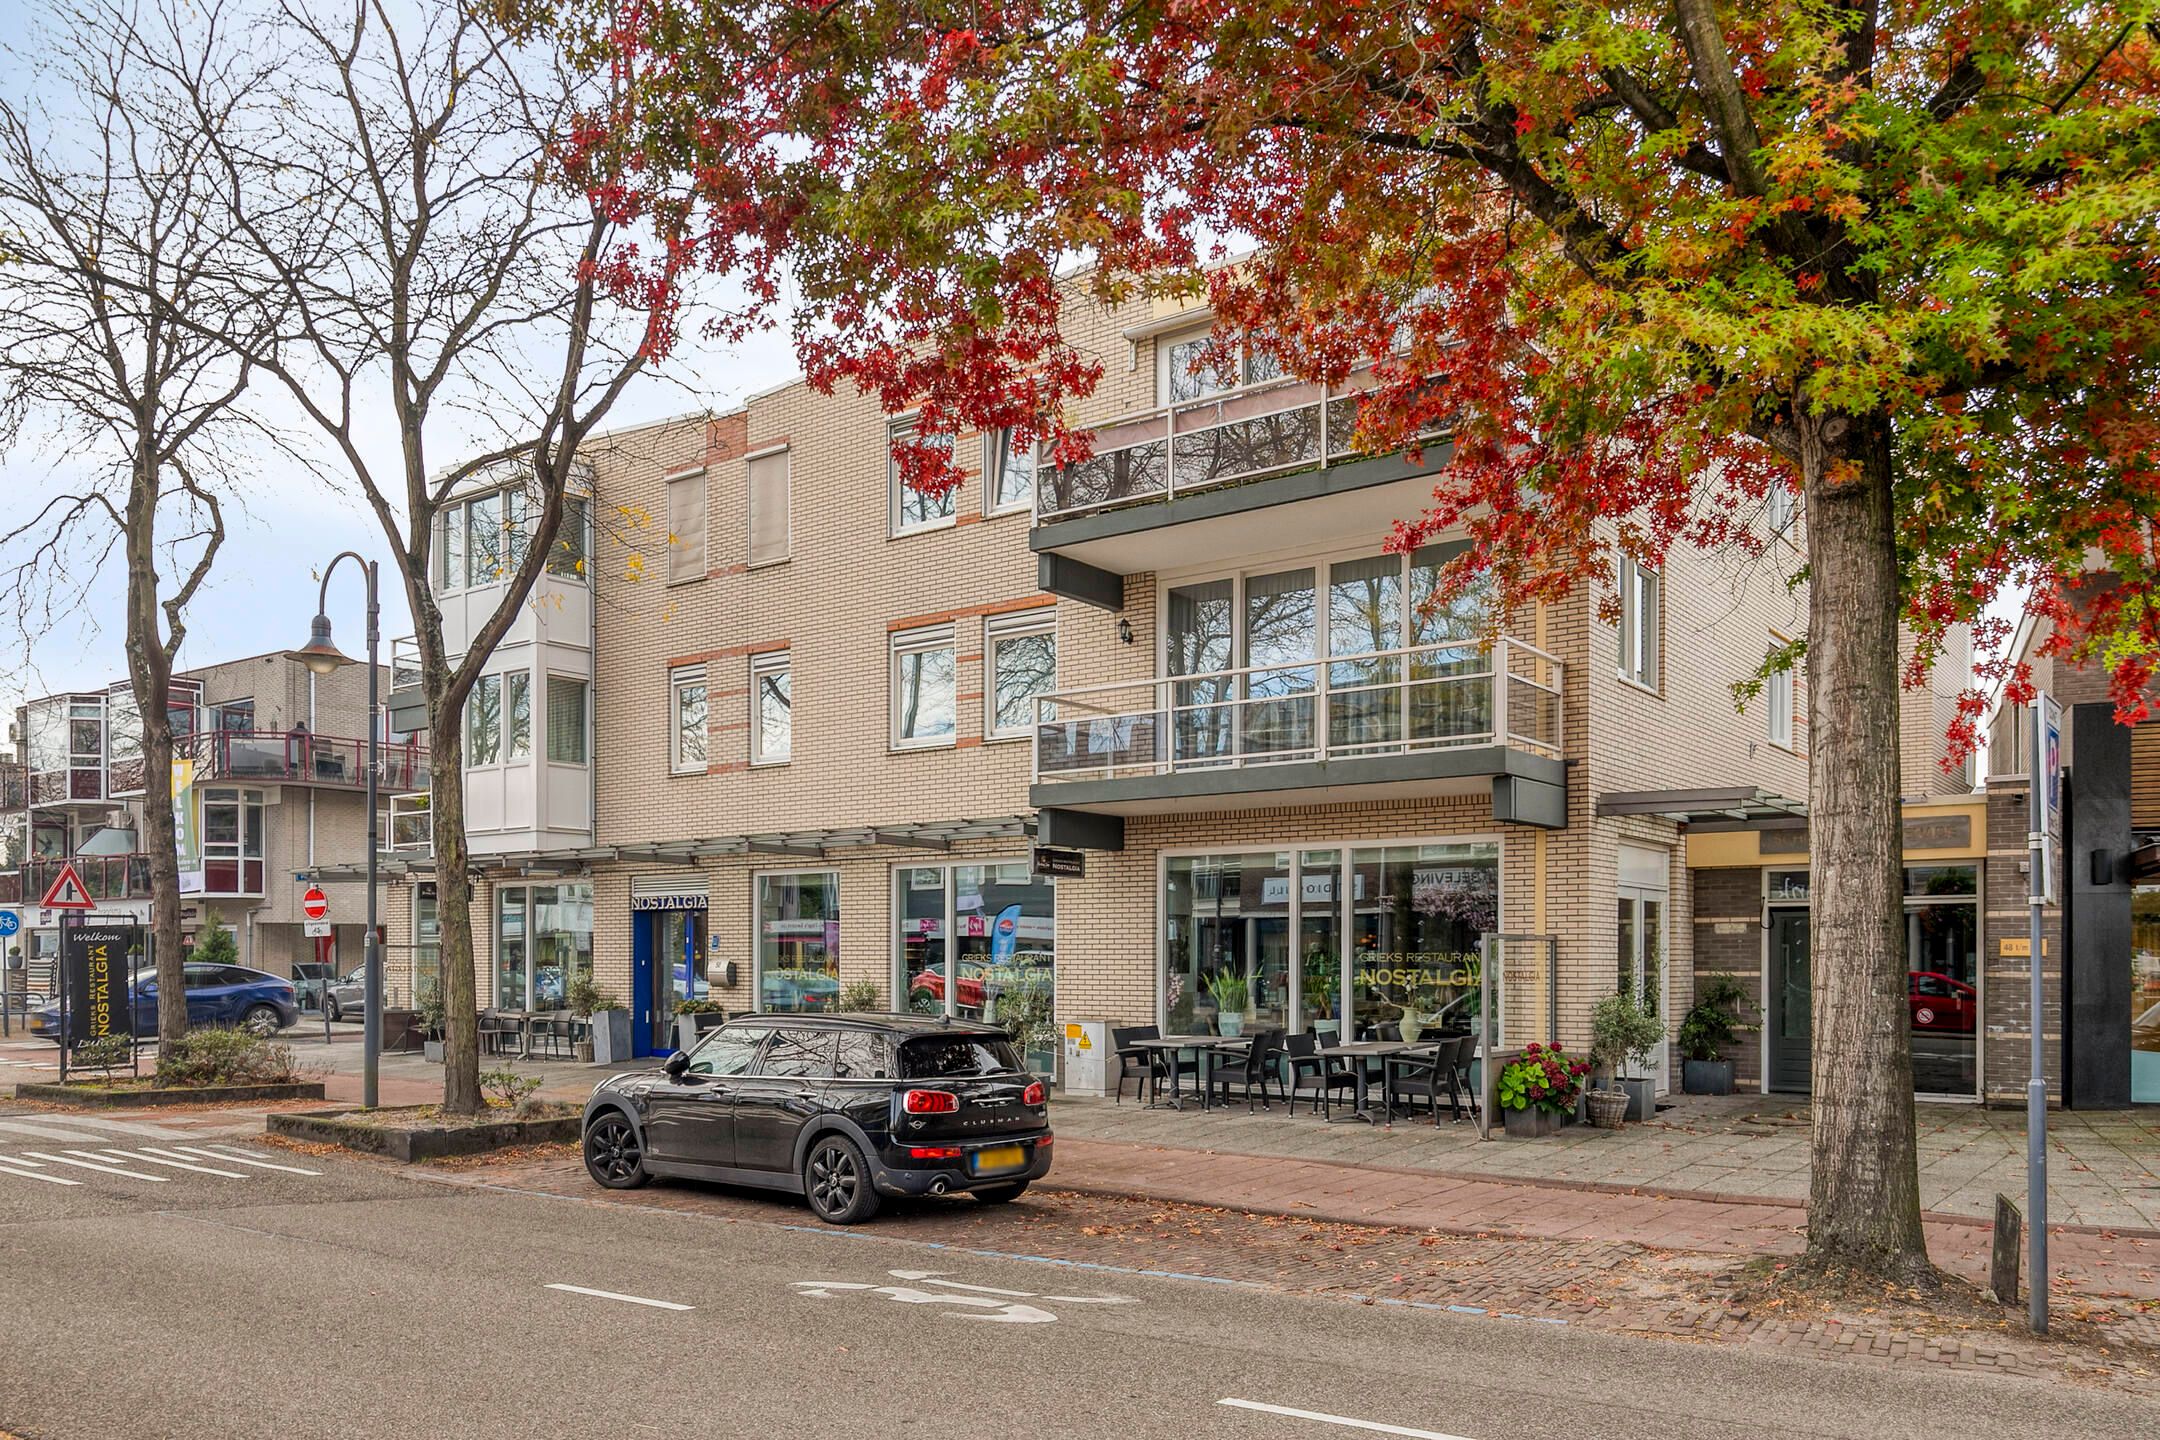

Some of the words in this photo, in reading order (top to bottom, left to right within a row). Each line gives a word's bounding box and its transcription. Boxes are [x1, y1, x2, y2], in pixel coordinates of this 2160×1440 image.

[1053, 863, 1081, 872] NOSTALGIA
[631, 895, 709, 910] NOSTALGIA
[73, 932, 121, 942] Welkom
[961, 953, 992, 962] GRIEKS
[1359, 952, 1403, 963] GRIEKS
[1406, 952, 1481, 963] RESTAURAN
[88, 944, 96, 1000] RESTAURANT
[764, 967, 839, 981] OSTALGIA
[962, 967, 1053, 982] NOSTALGIA
[95, 945, 110, 1036] NOSTALGIA
[89, 1005, 97, 1037] GRIEKS
[963, 1116, 1020, 1126] CLUBMAN
